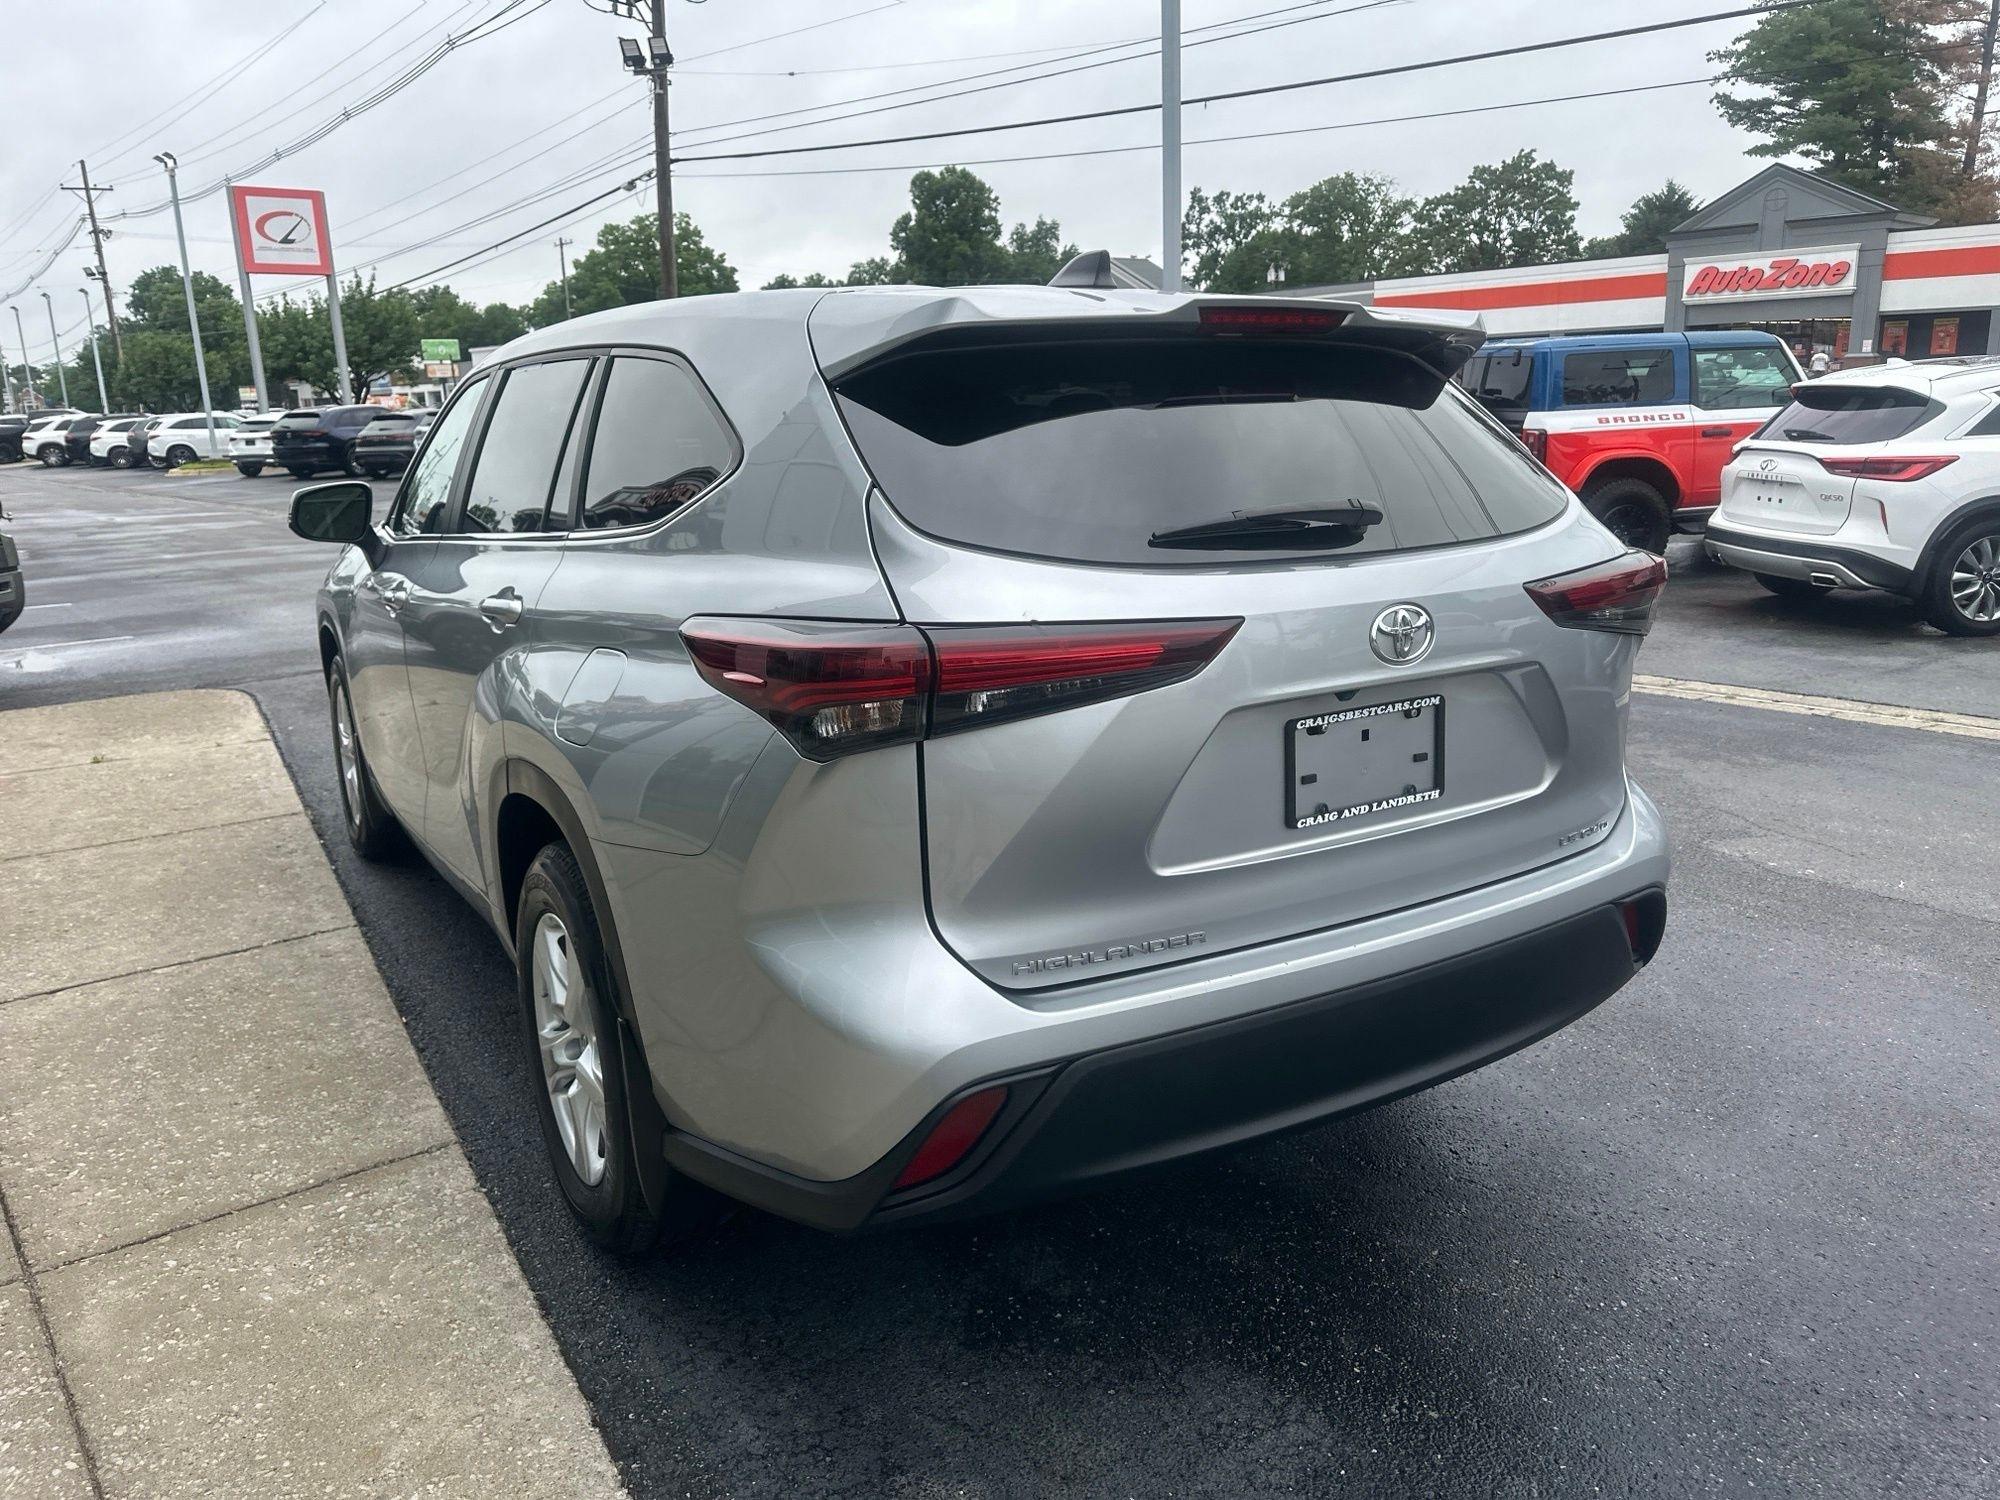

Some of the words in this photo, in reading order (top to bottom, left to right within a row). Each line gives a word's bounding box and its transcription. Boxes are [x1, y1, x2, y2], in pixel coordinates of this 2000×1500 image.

[1686, 258, 1851, 295] AutoZone
[1597, 413, 1685, 424] BRONCO
[1296, 696, 1441, 730] CRAIGSBESTCARS.COM
[1296, 811, 1339, 829] CRAIG
[1341, 804, 1370, 819] AND
[1372, 789, 1441, 812] LANDRETH
[1011, 931, 1207, 976] HIGHLANDER
